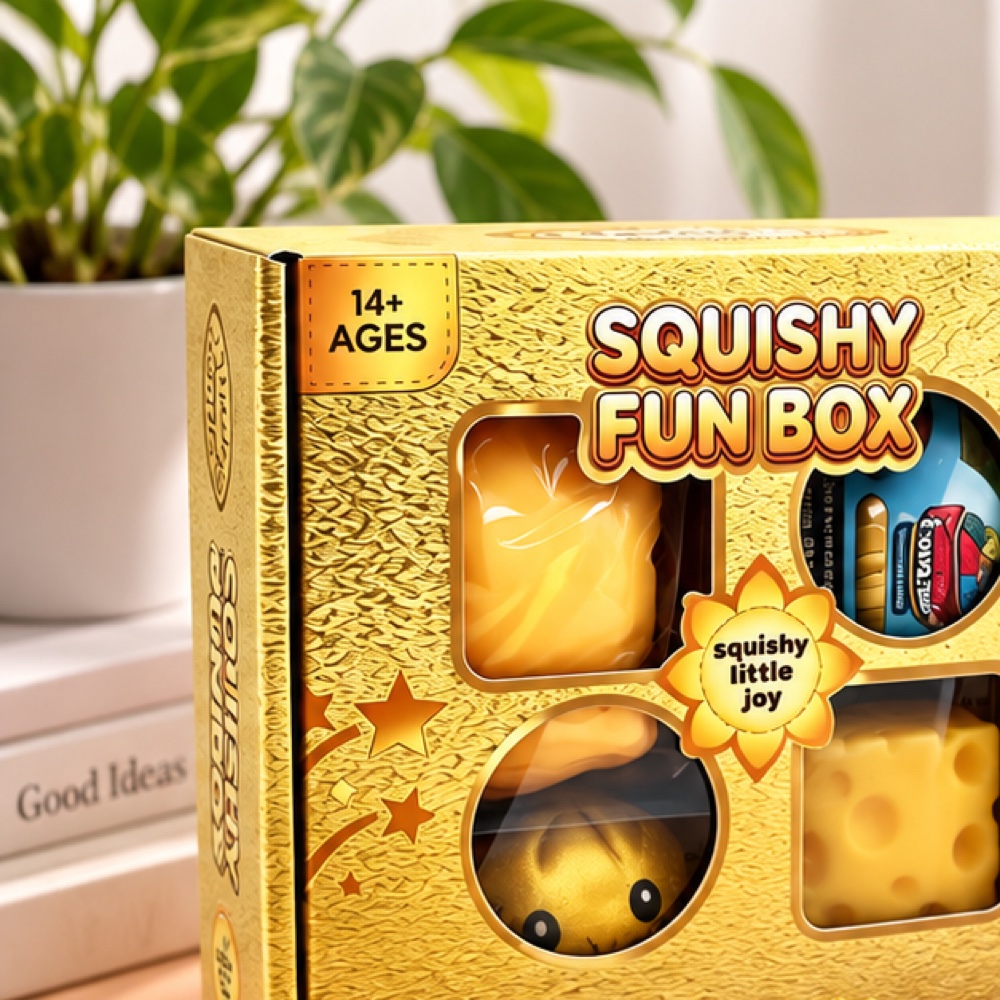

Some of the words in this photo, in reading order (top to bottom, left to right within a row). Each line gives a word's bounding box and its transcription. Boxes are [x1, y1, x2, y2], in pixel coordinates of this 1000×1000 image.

[350, 288, 403, 317] 14+
[328, 321, 427, 354] AGES
[589, 301, 921, 380] SQUISHY
[595, 387, 754, 465] FUN
[763, 382, 916, 460] BOX
[713, 633, 810, 663] squishy
[730, 660, 794, 685] little
[740, 688, 783, 714] joy
[16, 766, 100, 822] Good
[109, 756, 187, 799] Ideas
